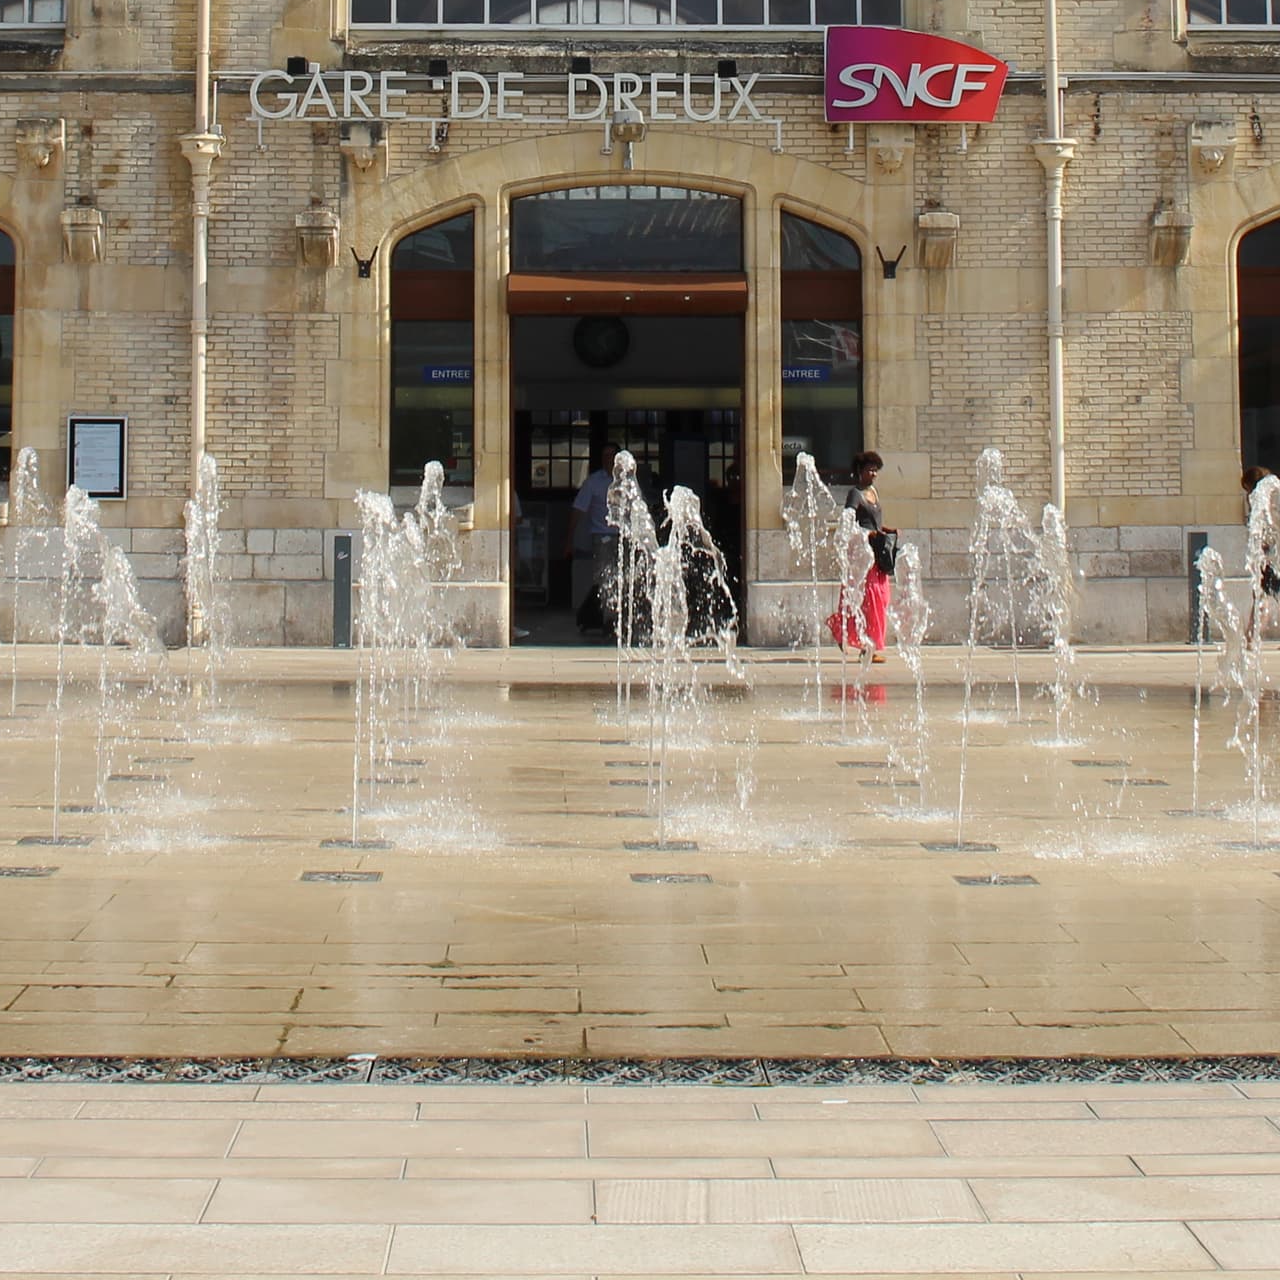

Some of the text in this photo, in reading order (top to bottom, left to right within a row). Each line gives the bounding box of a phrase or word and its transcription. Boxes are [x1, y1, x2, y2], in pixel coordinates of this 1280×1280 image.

[249, 69, 763, 121] GARE DE DREUX
[832, 63, 996, 108] SNCF
